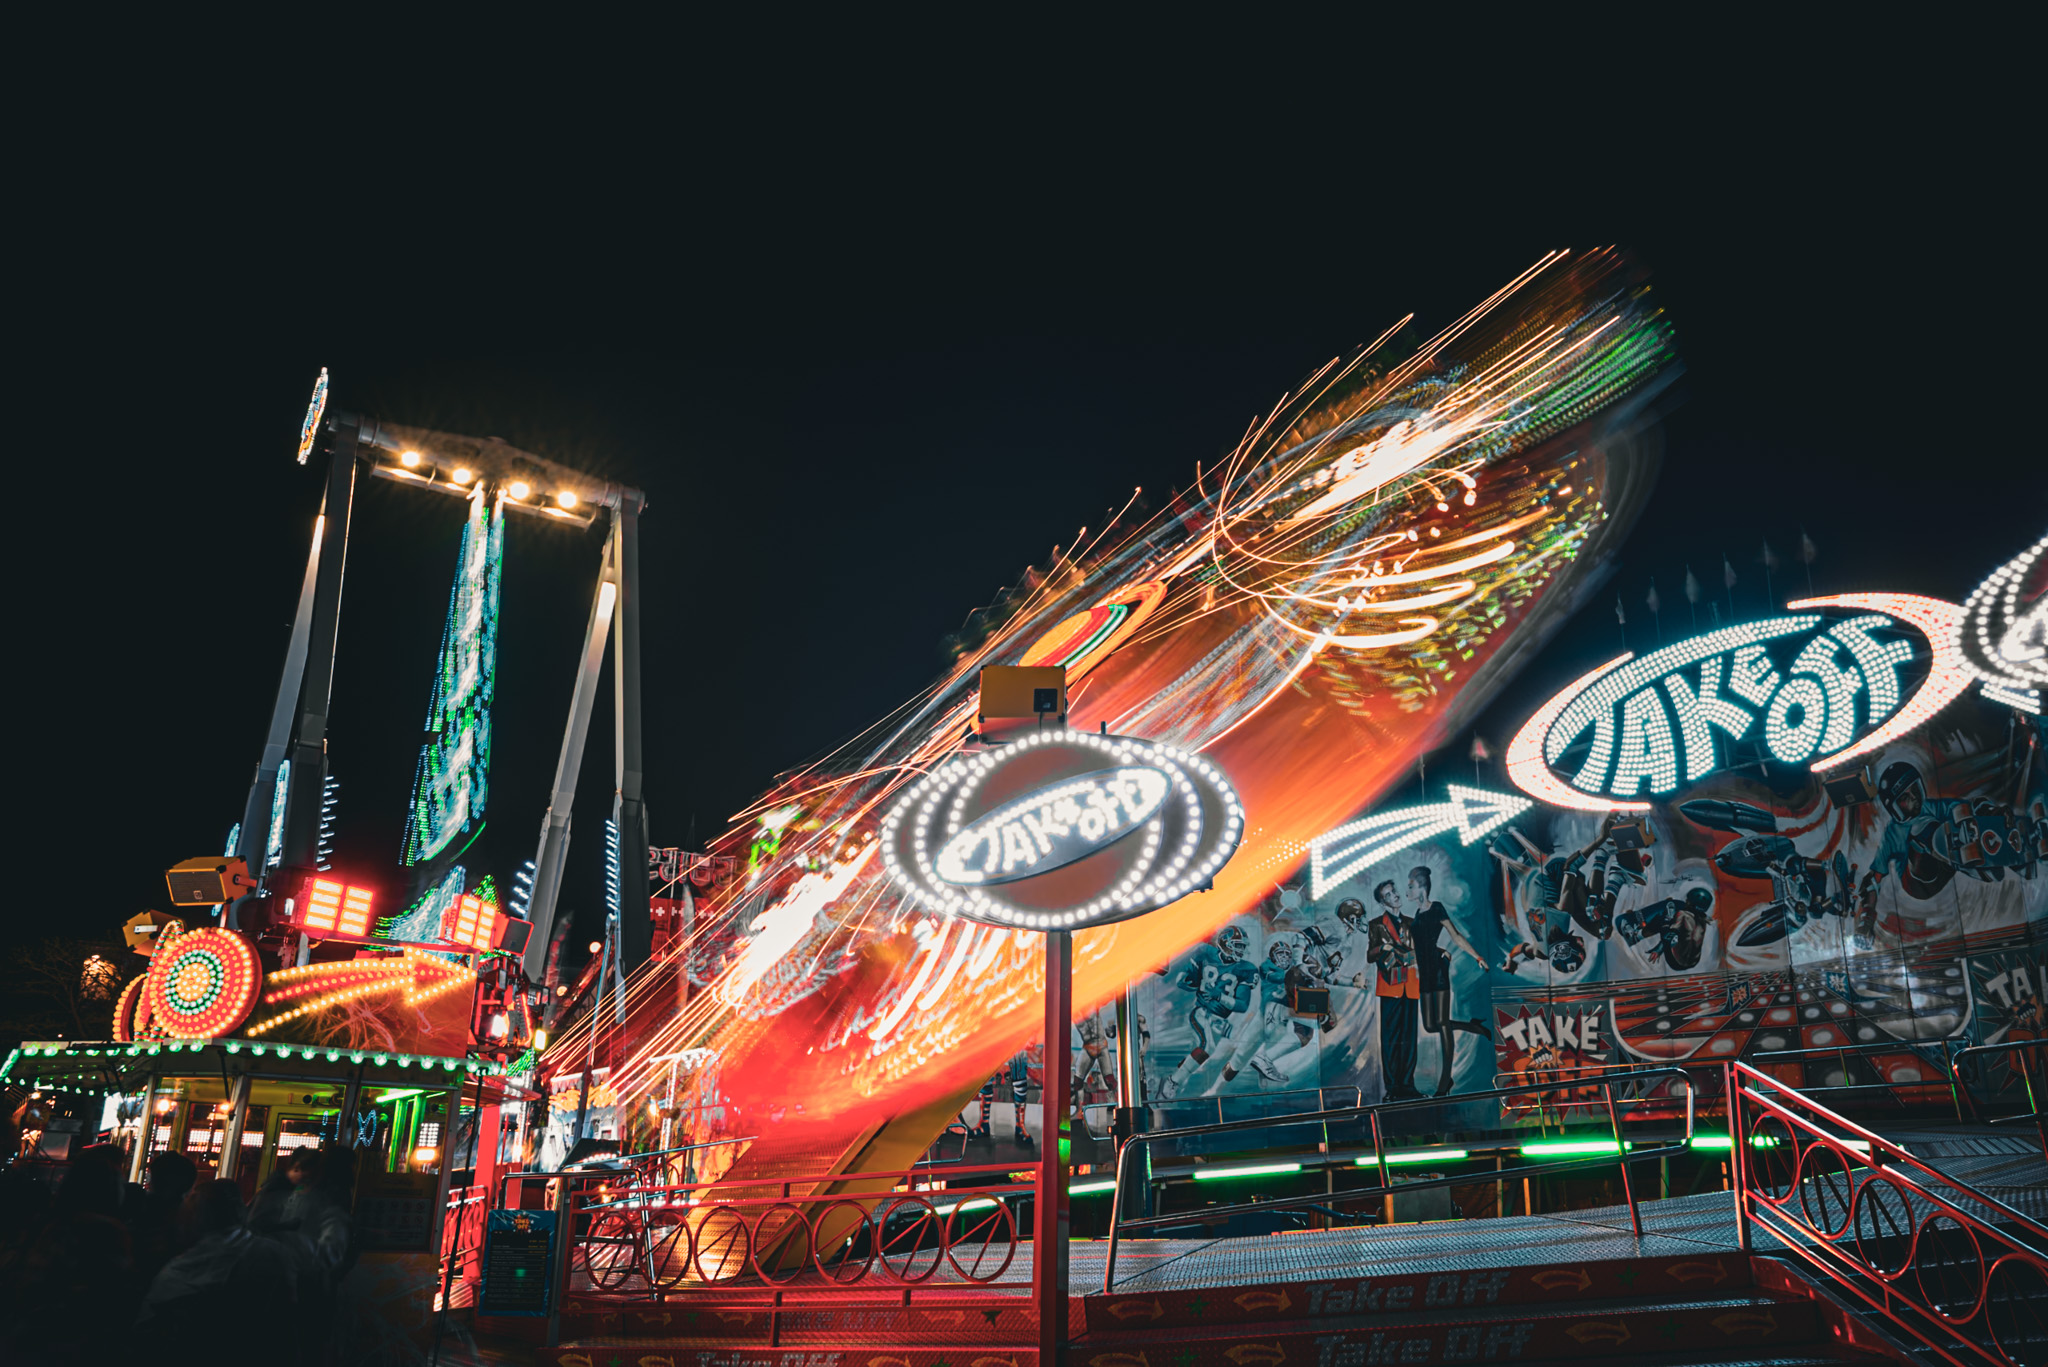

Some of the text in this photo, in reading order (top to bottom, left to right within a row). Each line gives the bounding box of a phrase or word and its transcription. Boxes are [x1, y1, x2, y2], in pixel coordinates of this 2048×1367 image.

[1545, 614, 1821, 797] TAKE
[1766, 614, 1914, 763] OFF
[961, 781, 1098, 874] TAKE
[1500, 1015, 1600, 1051] TAKE
[1304, 1280, 1415, 1315] Take
[1313, 1333, 1432, 1367] Take
